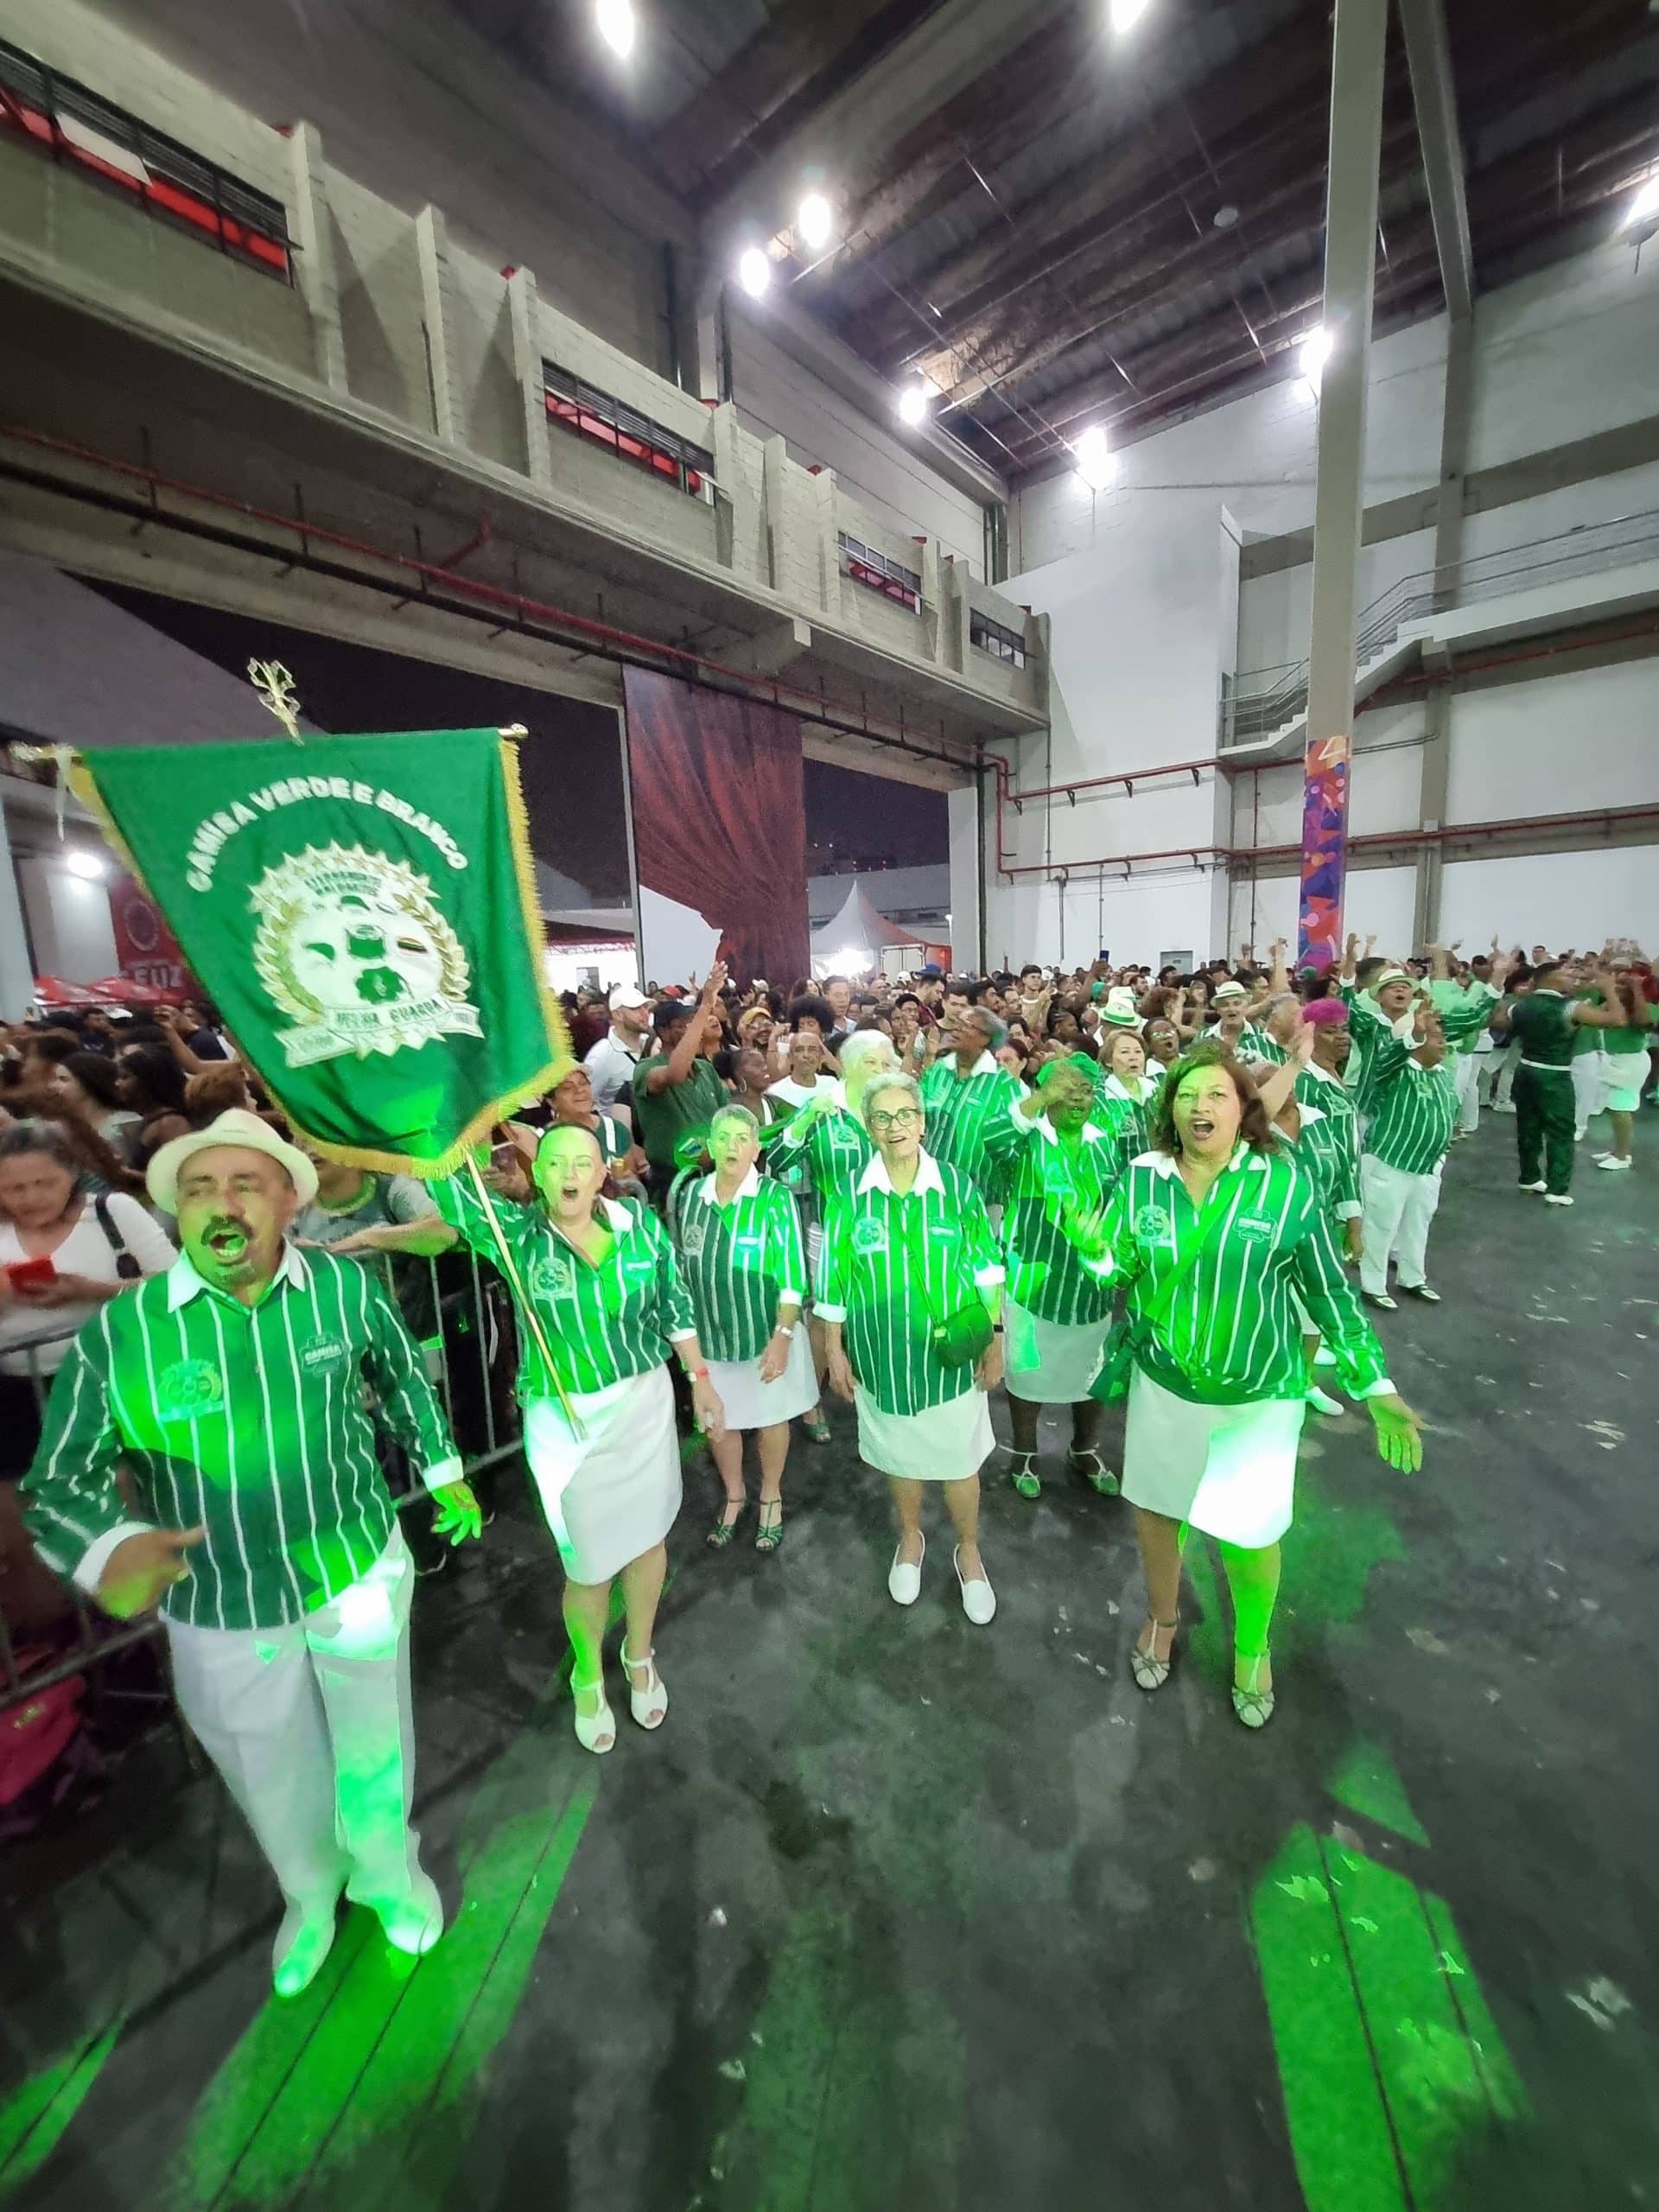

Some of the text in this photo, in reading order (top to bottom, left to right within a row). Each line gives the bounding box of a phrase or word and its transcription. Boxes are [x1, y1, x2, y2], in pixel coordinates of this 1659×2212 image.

[186, 776, 468, 892] CAMISA VERDE E BRANCO
